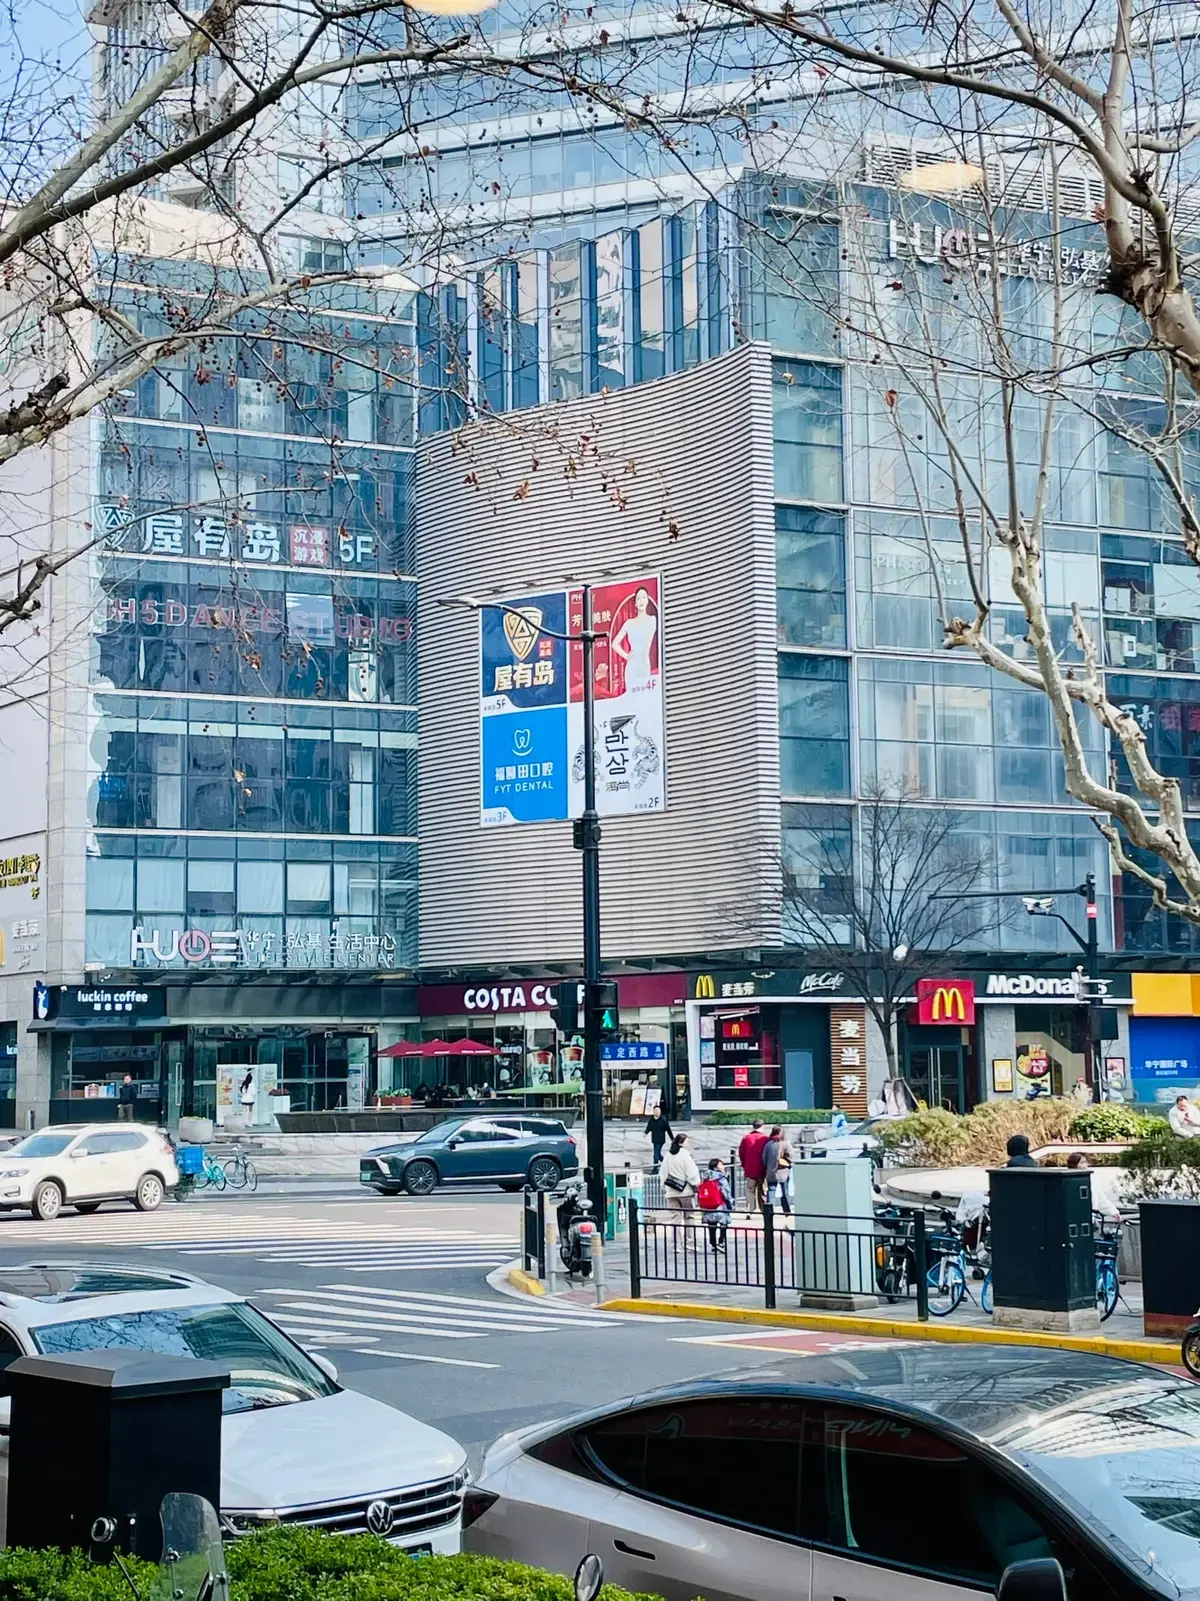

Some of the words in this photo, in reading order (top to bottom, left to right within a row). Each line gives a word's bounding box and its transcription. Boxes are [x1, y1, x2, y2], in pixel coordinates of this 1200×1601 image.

[142, 515, 280, 563] 屋有岛
[340, 535, 373, 563] 5F
[494, 660, 554, 692] 屋有岛
[496, 699, 506, 710] 5F
[494, 784, 511, 795] FYT
[515, 781, 553, 793] DENTAL
[648, 797, 660, 808] 2F
[498, 811, 507, 823] 3F
[328, 932, 397, 951] 生活中心
[338, 952, 394, 964] CENTER
[77, 989, 112, 1003] luckin
[113, 990, 149, 1003] coffee
[722, 981, 755, 997] 麦当劳
[463, 987, 527, 1011] COSTA
[616, 1046, 649, 1059] 定西路
[839, 1018, 861, 1095] 麦当劳
